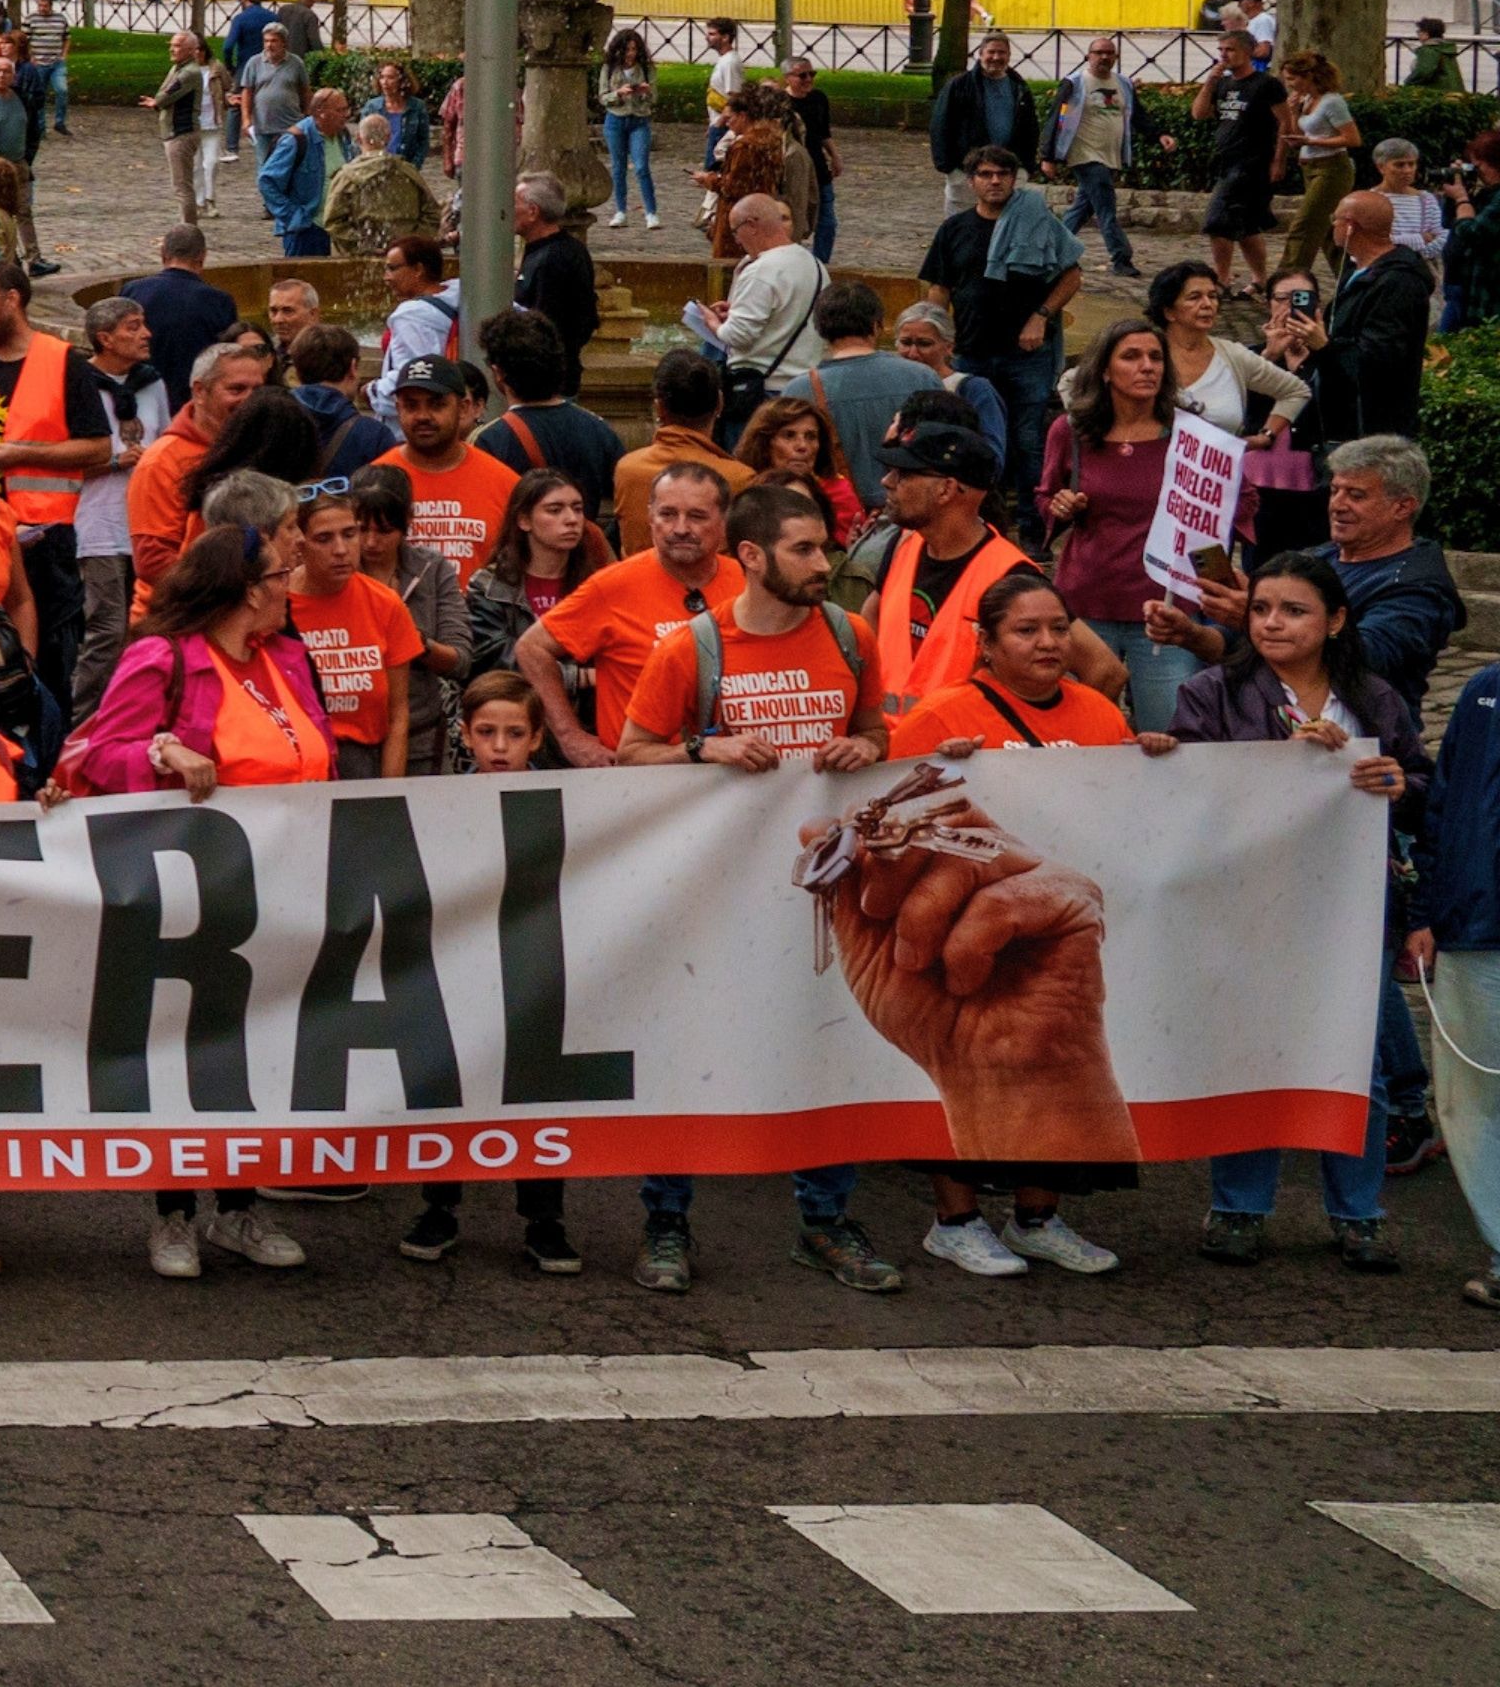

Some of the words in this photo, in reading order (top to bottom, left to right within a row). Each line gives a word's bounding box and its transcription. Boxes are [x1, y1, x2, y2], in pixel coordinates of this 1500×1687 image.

[1175, 430, 1200, 462] POR
[1200, 444, 1233, 480] UNA
[1174, 461, 1223, 508] HUELGA
[1166, 489, 1221, 539] GENERAL
[721, 669, 809, 696] SINDICATO
[725, 703, 749, 722] DE
[750, 695, 843, 721] INQUILINAS
[8, 1127, 575, 1178] INDEFINIDOS
